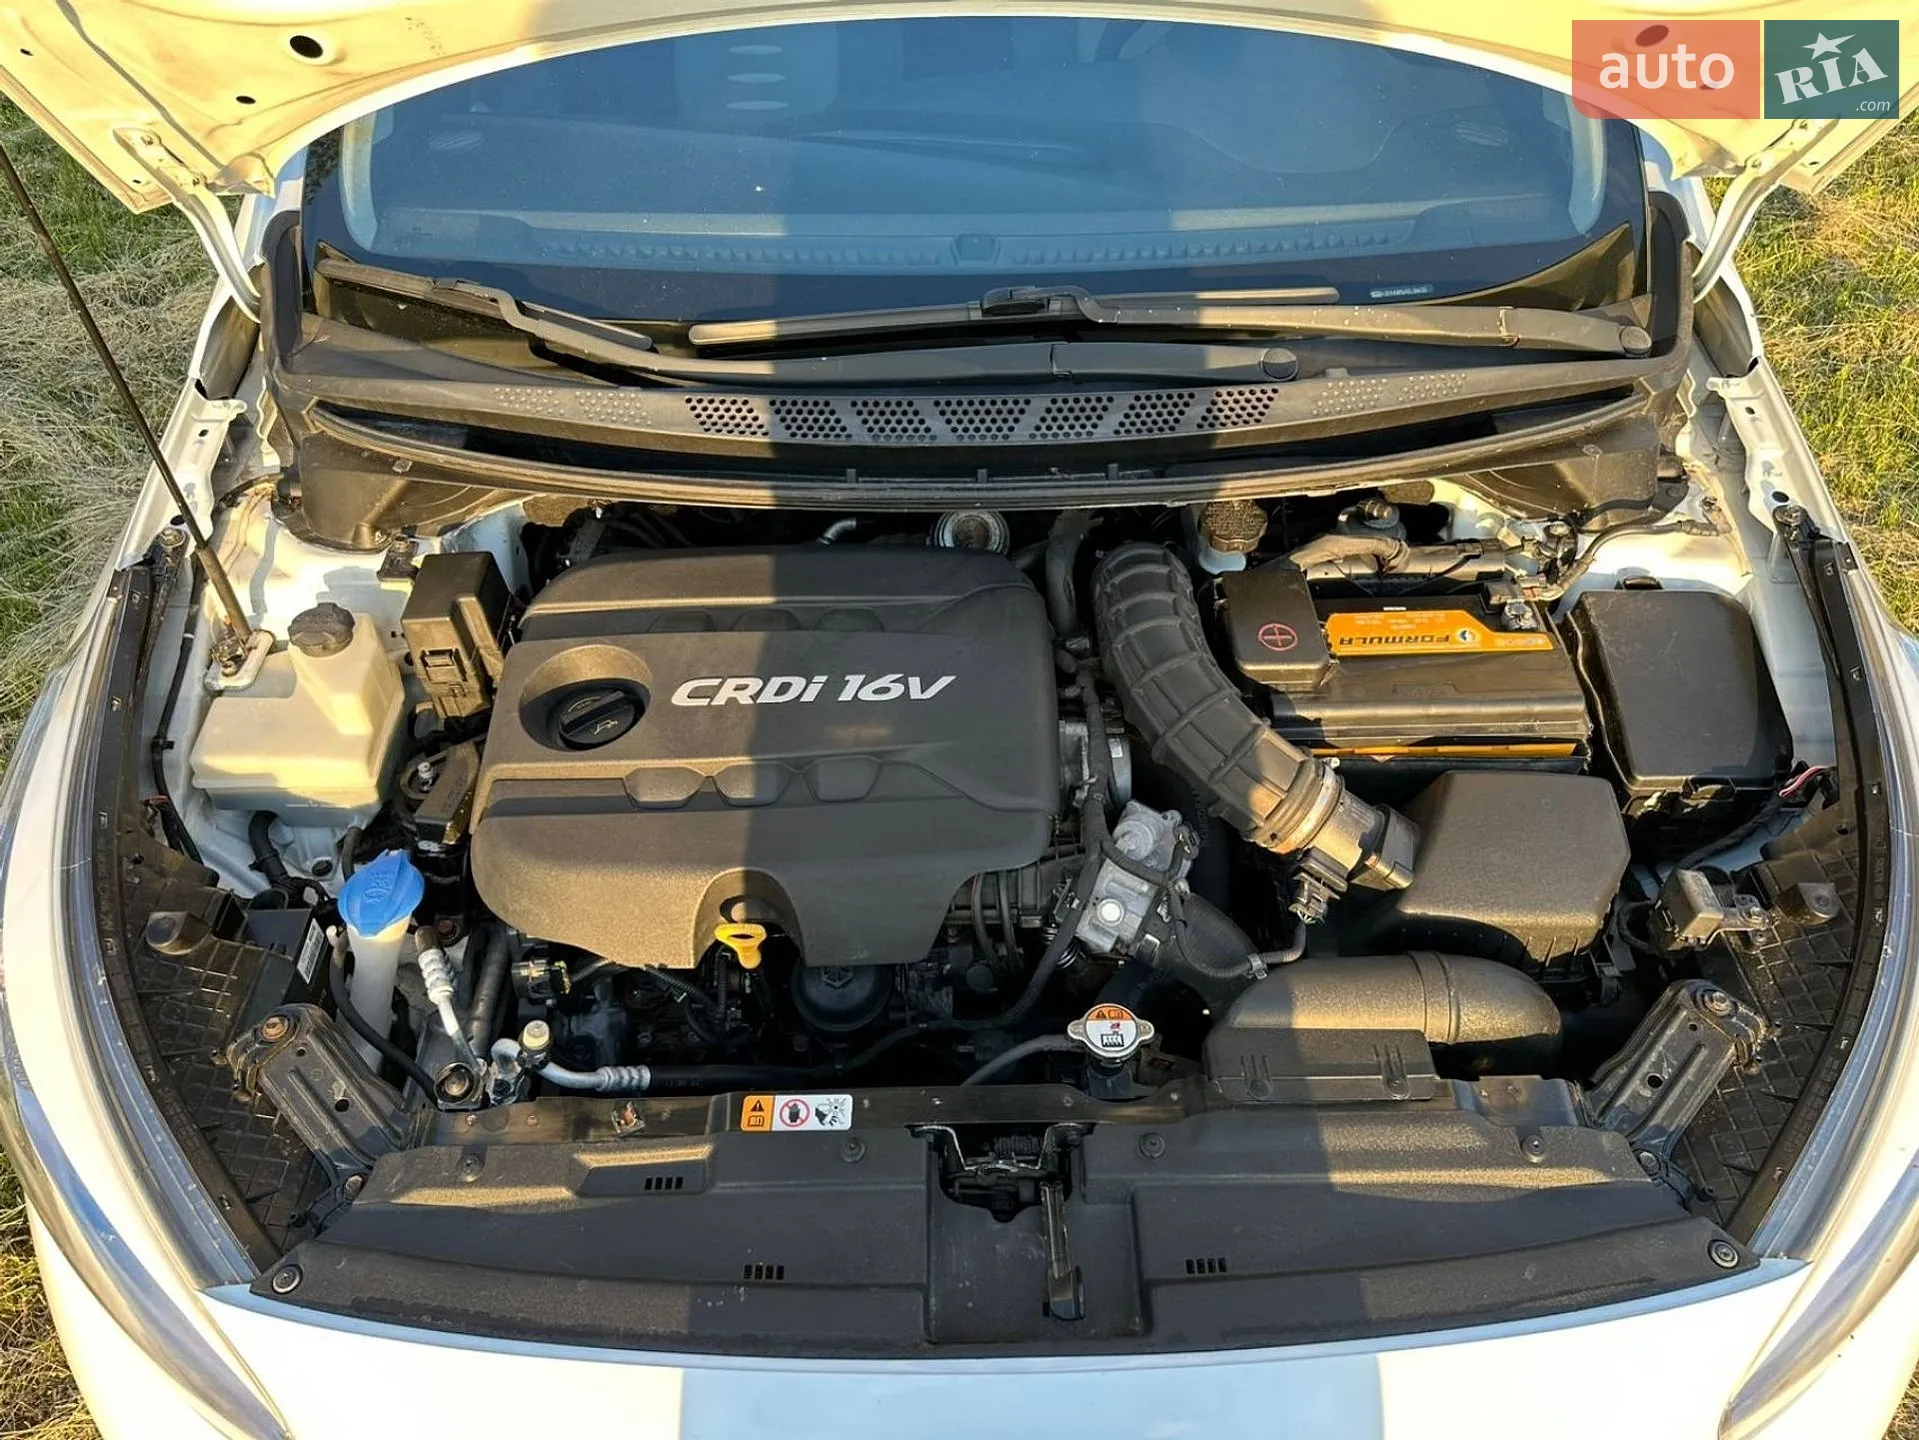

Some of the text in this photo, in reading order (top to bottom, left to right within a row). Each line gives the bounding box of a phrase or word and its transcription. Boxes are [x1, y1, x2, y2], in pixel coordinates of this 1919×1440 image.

[1339, 634, 1450, 646] FORMULA
[671, 674, 957, 706] CRDi 16V
